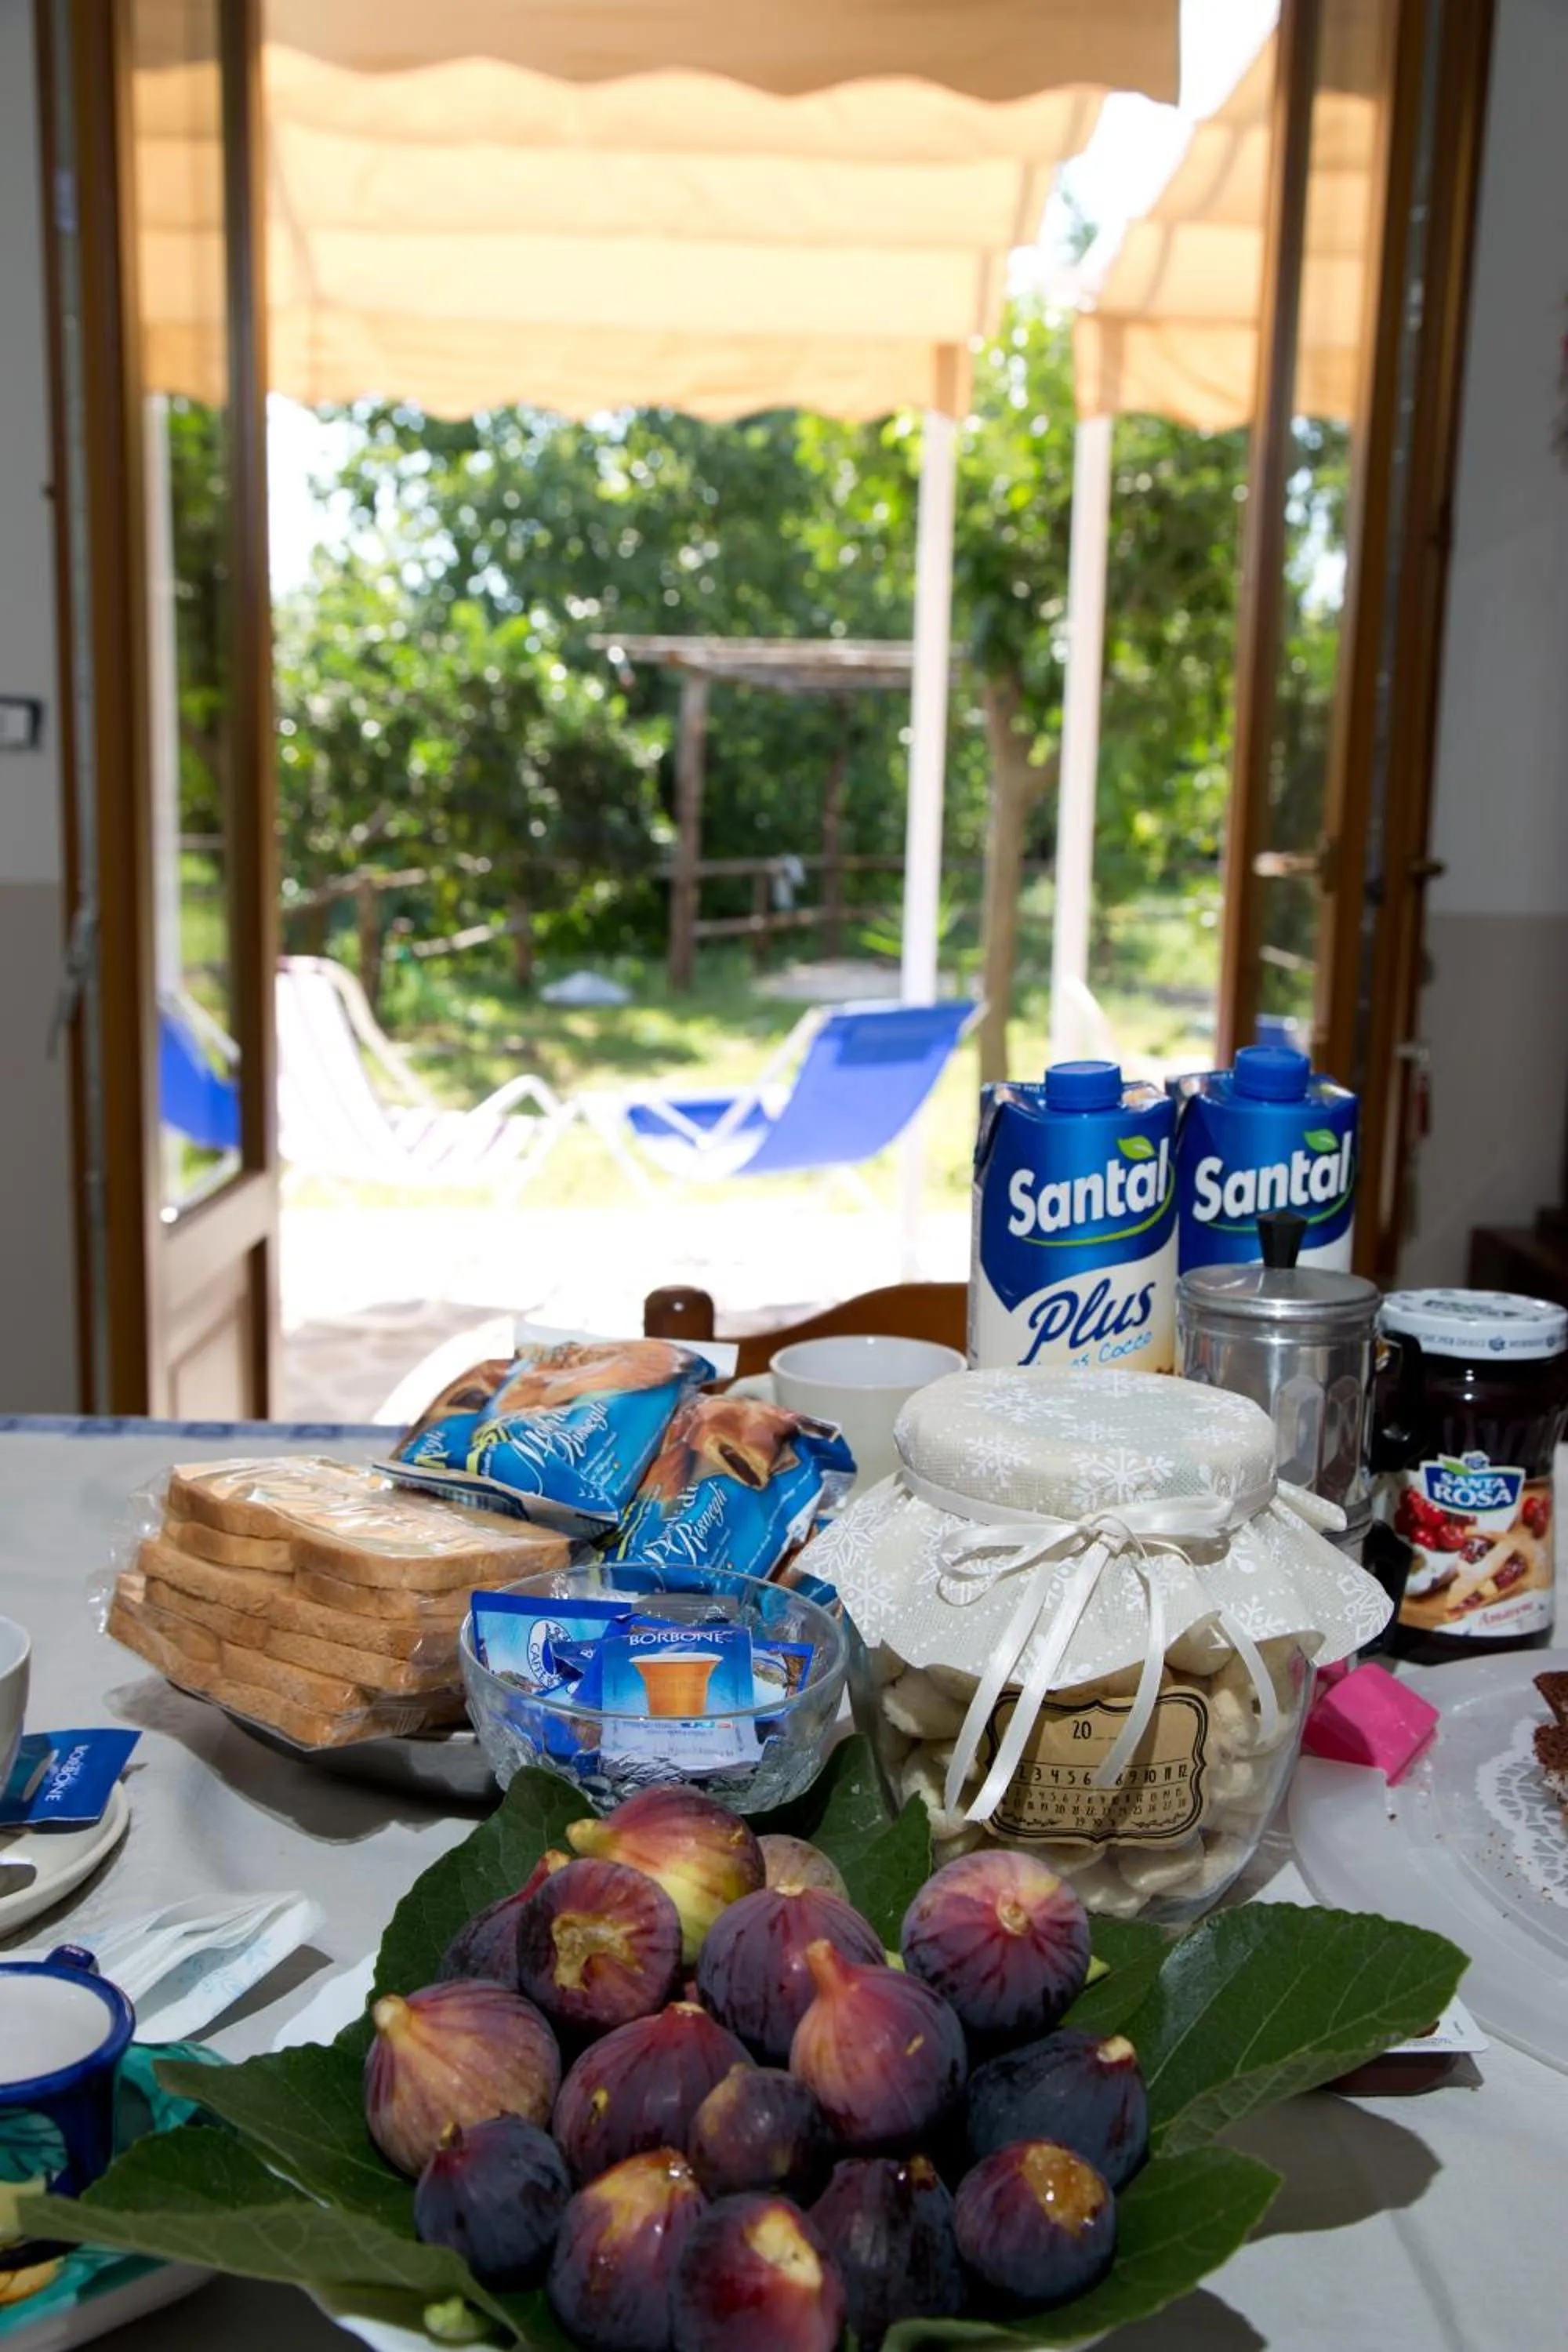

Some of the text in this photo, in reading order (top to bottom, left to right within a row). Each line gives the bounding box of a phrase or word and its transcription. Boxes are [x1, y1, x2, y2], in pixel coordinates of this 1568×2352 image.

[1007, 1137, 1169, 1237] Santal
[1192, 1131, 1352, 1222] Santal
[1018, 1277, 1156, 1366] Plus
[1440, 1472, 1507, 1488] SANTA
[1433, 1482, 1514, 1508] ROSA
[630, 1631, 724, 1646] BORBONE
[1072, 1720, 1092, 1740] 20
[1034, 1766, 1043, 1780] 3
[1051, 1768, 1059, 1784] 4
[1067, 1769, 1076, 1784] 5
[1083, 1771, 1092, 1785] 6
